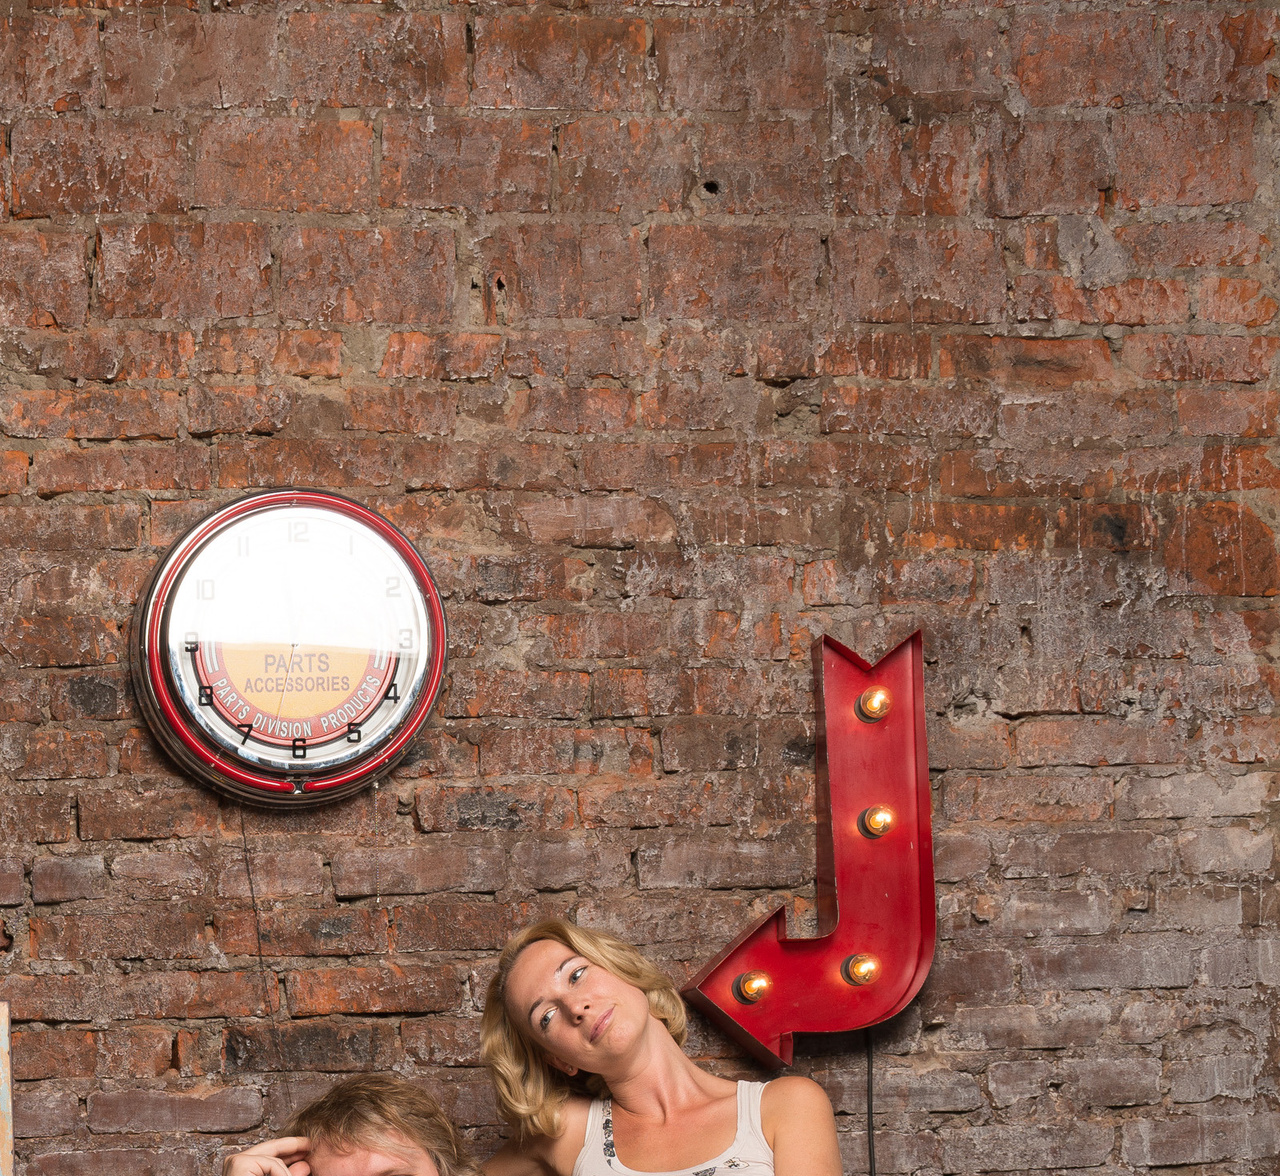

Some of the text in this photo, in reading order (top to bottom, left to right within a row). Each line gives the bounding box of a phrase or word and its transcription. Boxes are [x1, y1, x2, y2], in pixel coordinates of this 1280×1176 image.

[264, 653, 330, 674] PARTS
[198, 685, 214, 706] 8
[243, 676, 351, 694] ACCESSORIES
[384, 683, 401, 704] 4
[212, 674, 381, 739] PARTS DIVISION PRODUCTS
[237, 723, 253, 745] 7
[347, 723, 361, 744] 5
[292, 738, 307, 760] 6
